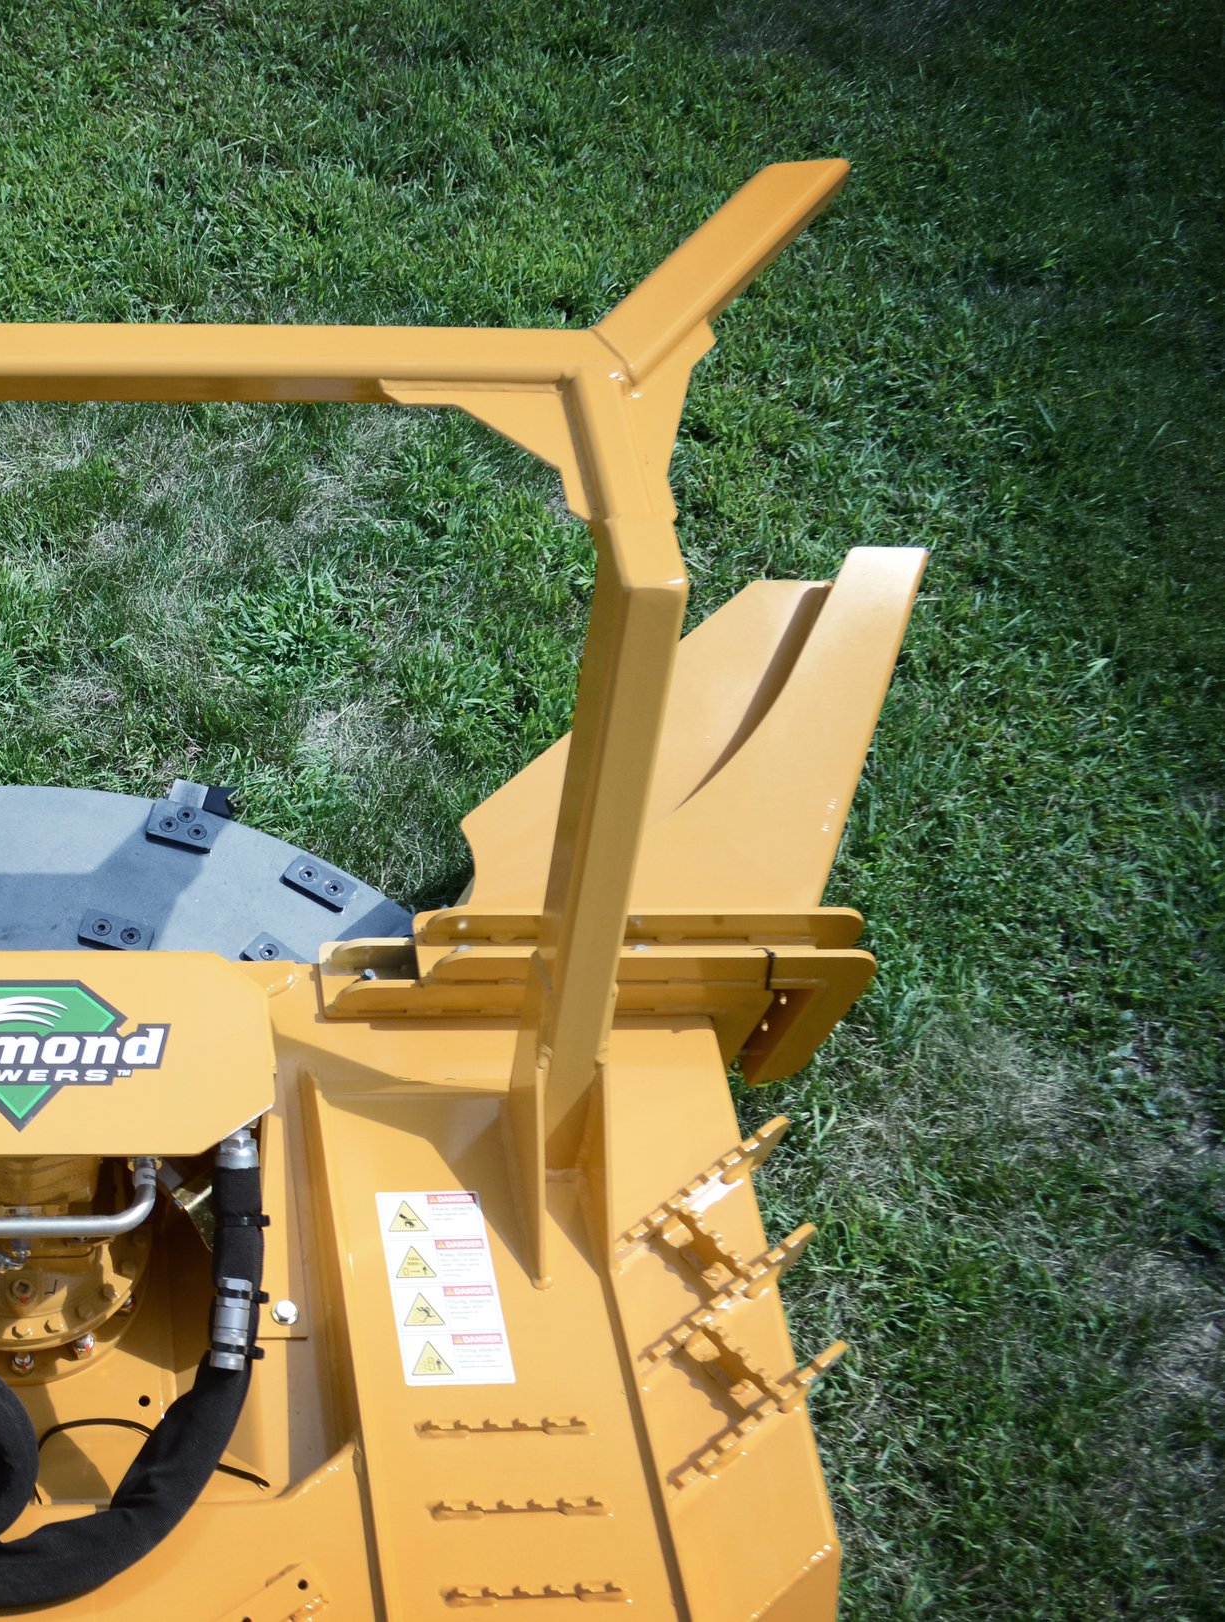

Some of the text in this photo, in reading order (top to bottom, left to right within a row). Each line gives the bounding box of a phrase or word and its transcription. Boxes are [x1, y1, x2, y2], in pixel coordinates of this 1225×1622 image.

[435, 1194, 474, 1203] DANGER
[445, 1240, 484, 1249] DANGER
[454, 1287, 493, 1295] DANGER
[463, 1335, 502, 1343] DANGER
